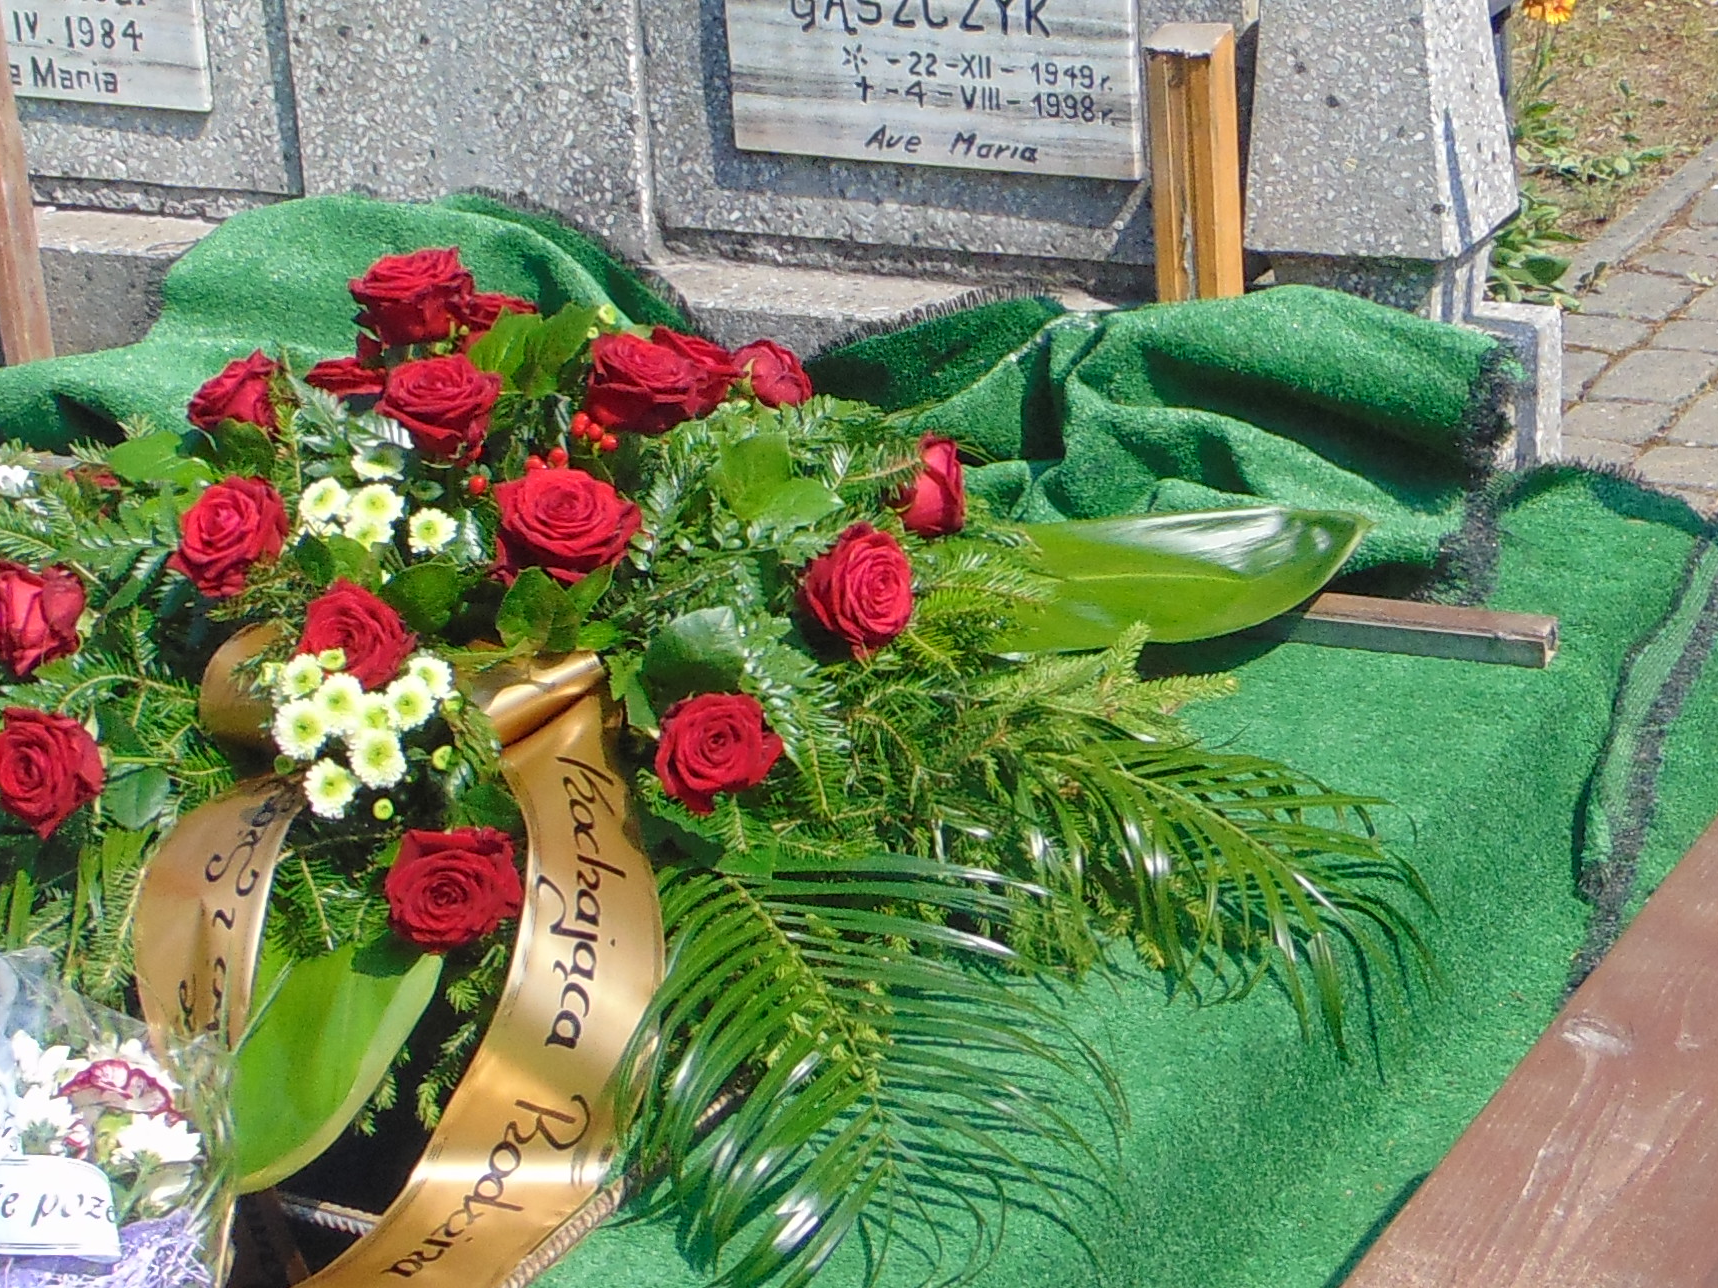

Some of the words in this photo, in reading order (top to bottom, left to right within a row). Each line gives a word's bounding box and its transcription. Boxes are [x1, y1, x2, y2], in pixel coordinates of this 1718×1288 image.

[64, 14, 144, 52] 1984
[29, 55, 119, 94] Maria
[864, 123, 923, 154] Ave
[949, 131, 1040, 163] Maria
